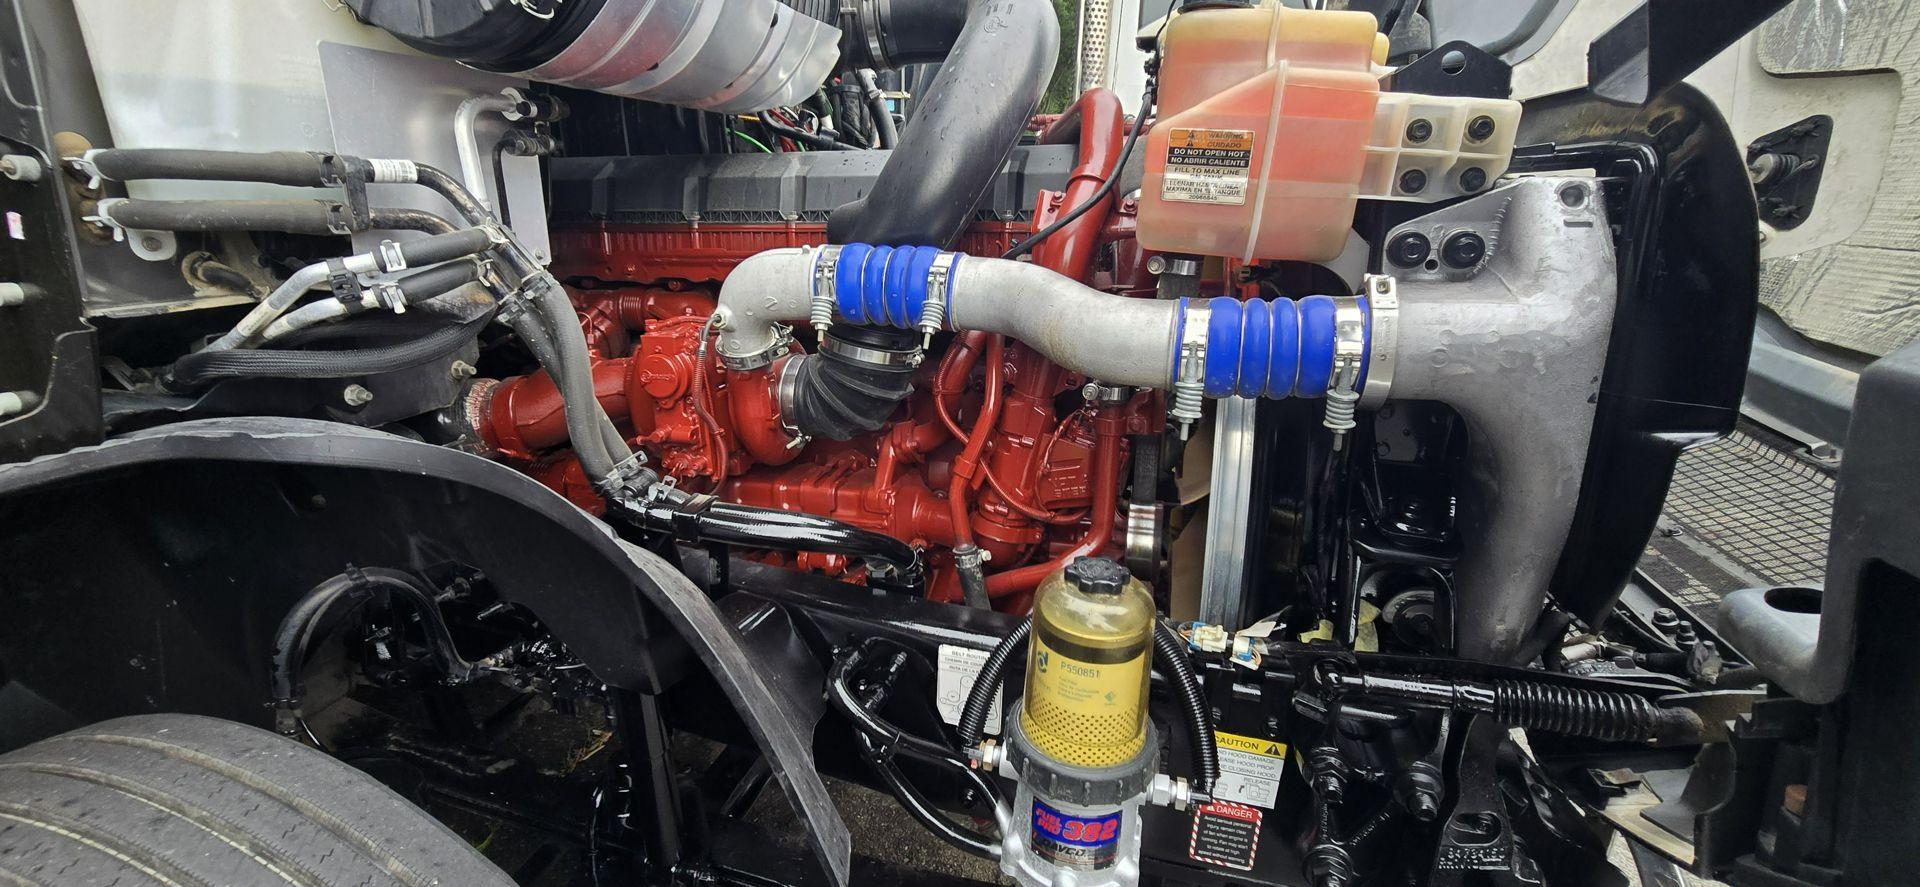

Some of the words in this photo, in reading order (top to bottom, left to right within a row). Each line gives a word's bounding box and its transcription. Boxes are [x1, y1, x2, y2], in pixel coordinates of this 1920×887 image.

[1060, 661, 1101, 679] P550851
[1216, 736, 1259, 750] CAUTION
[1228, 751, 1247, 759] HOOD
[1216, 806, 1253, 818] DANGER
[1062, 818, 1118, 842] 382
